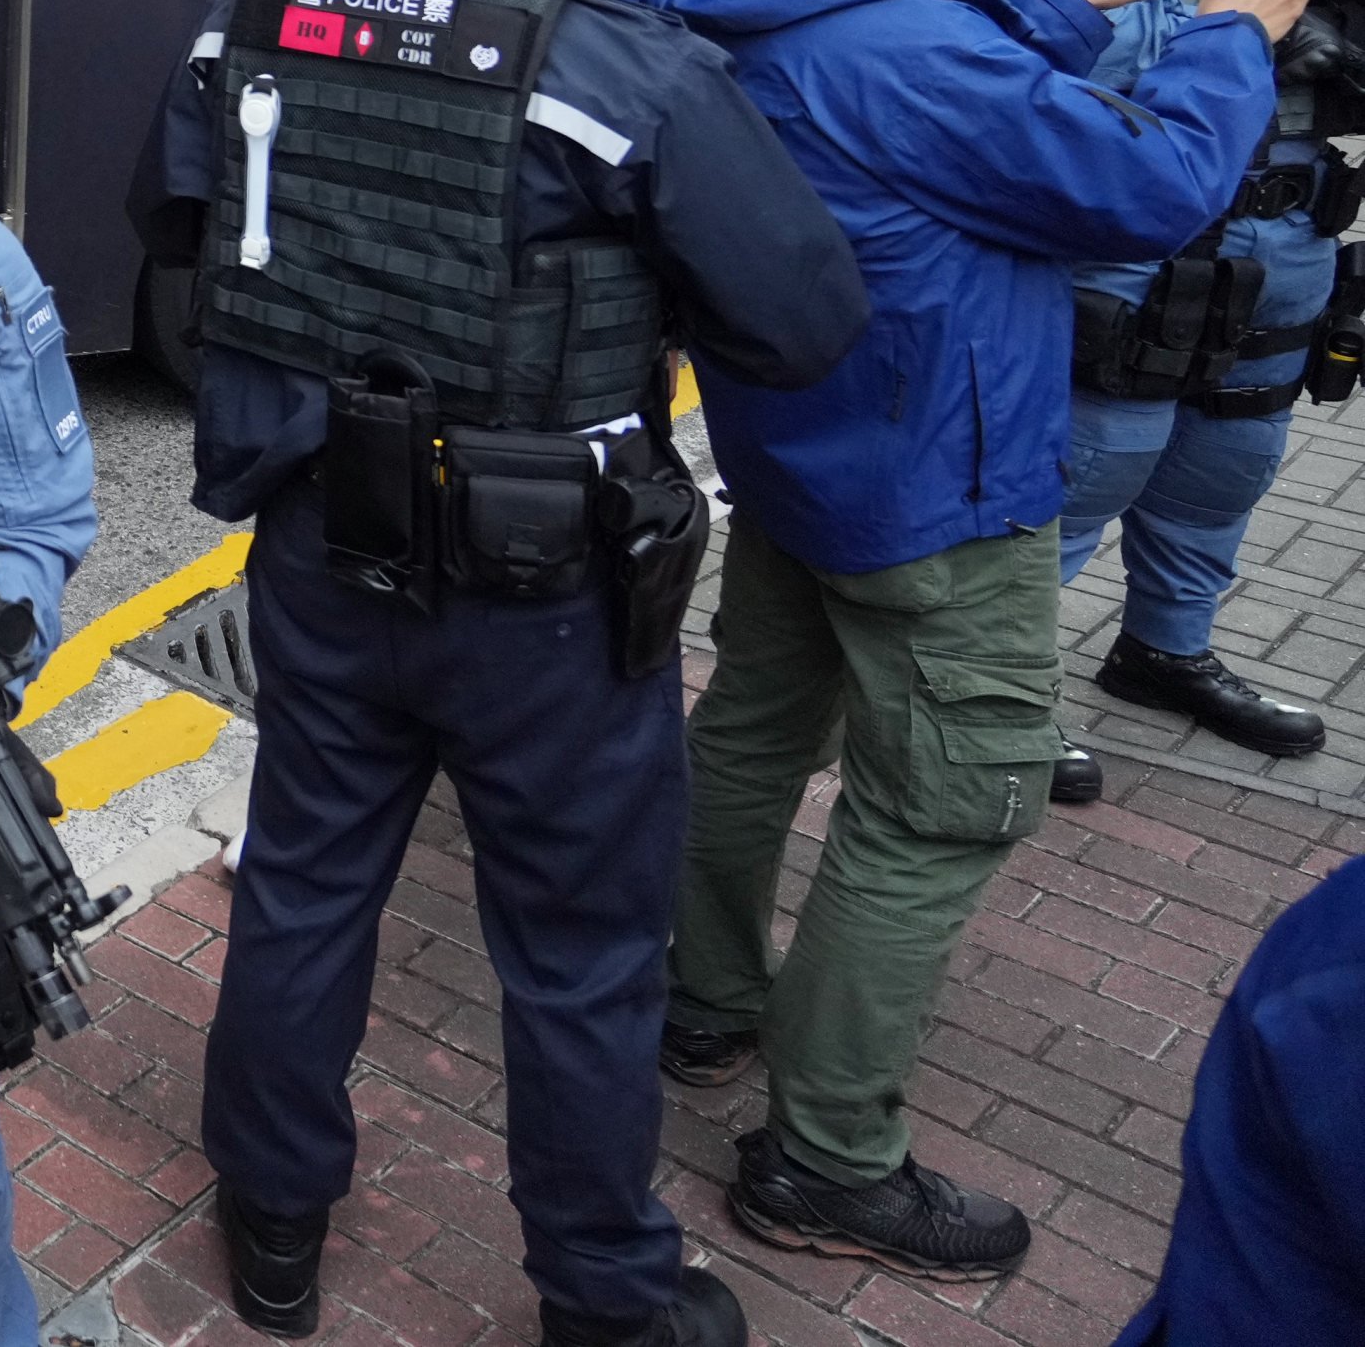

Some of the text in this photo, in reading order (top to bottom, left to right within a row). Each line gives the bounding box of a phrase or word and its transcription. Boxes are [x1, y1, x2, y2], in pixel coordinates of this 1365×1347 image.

[296, 21, 327, 40] HQ
[401, 29, 435, 47] COY
[397, 47, 432, 65] CDR
[27, 304, 52, 334] CTRU
